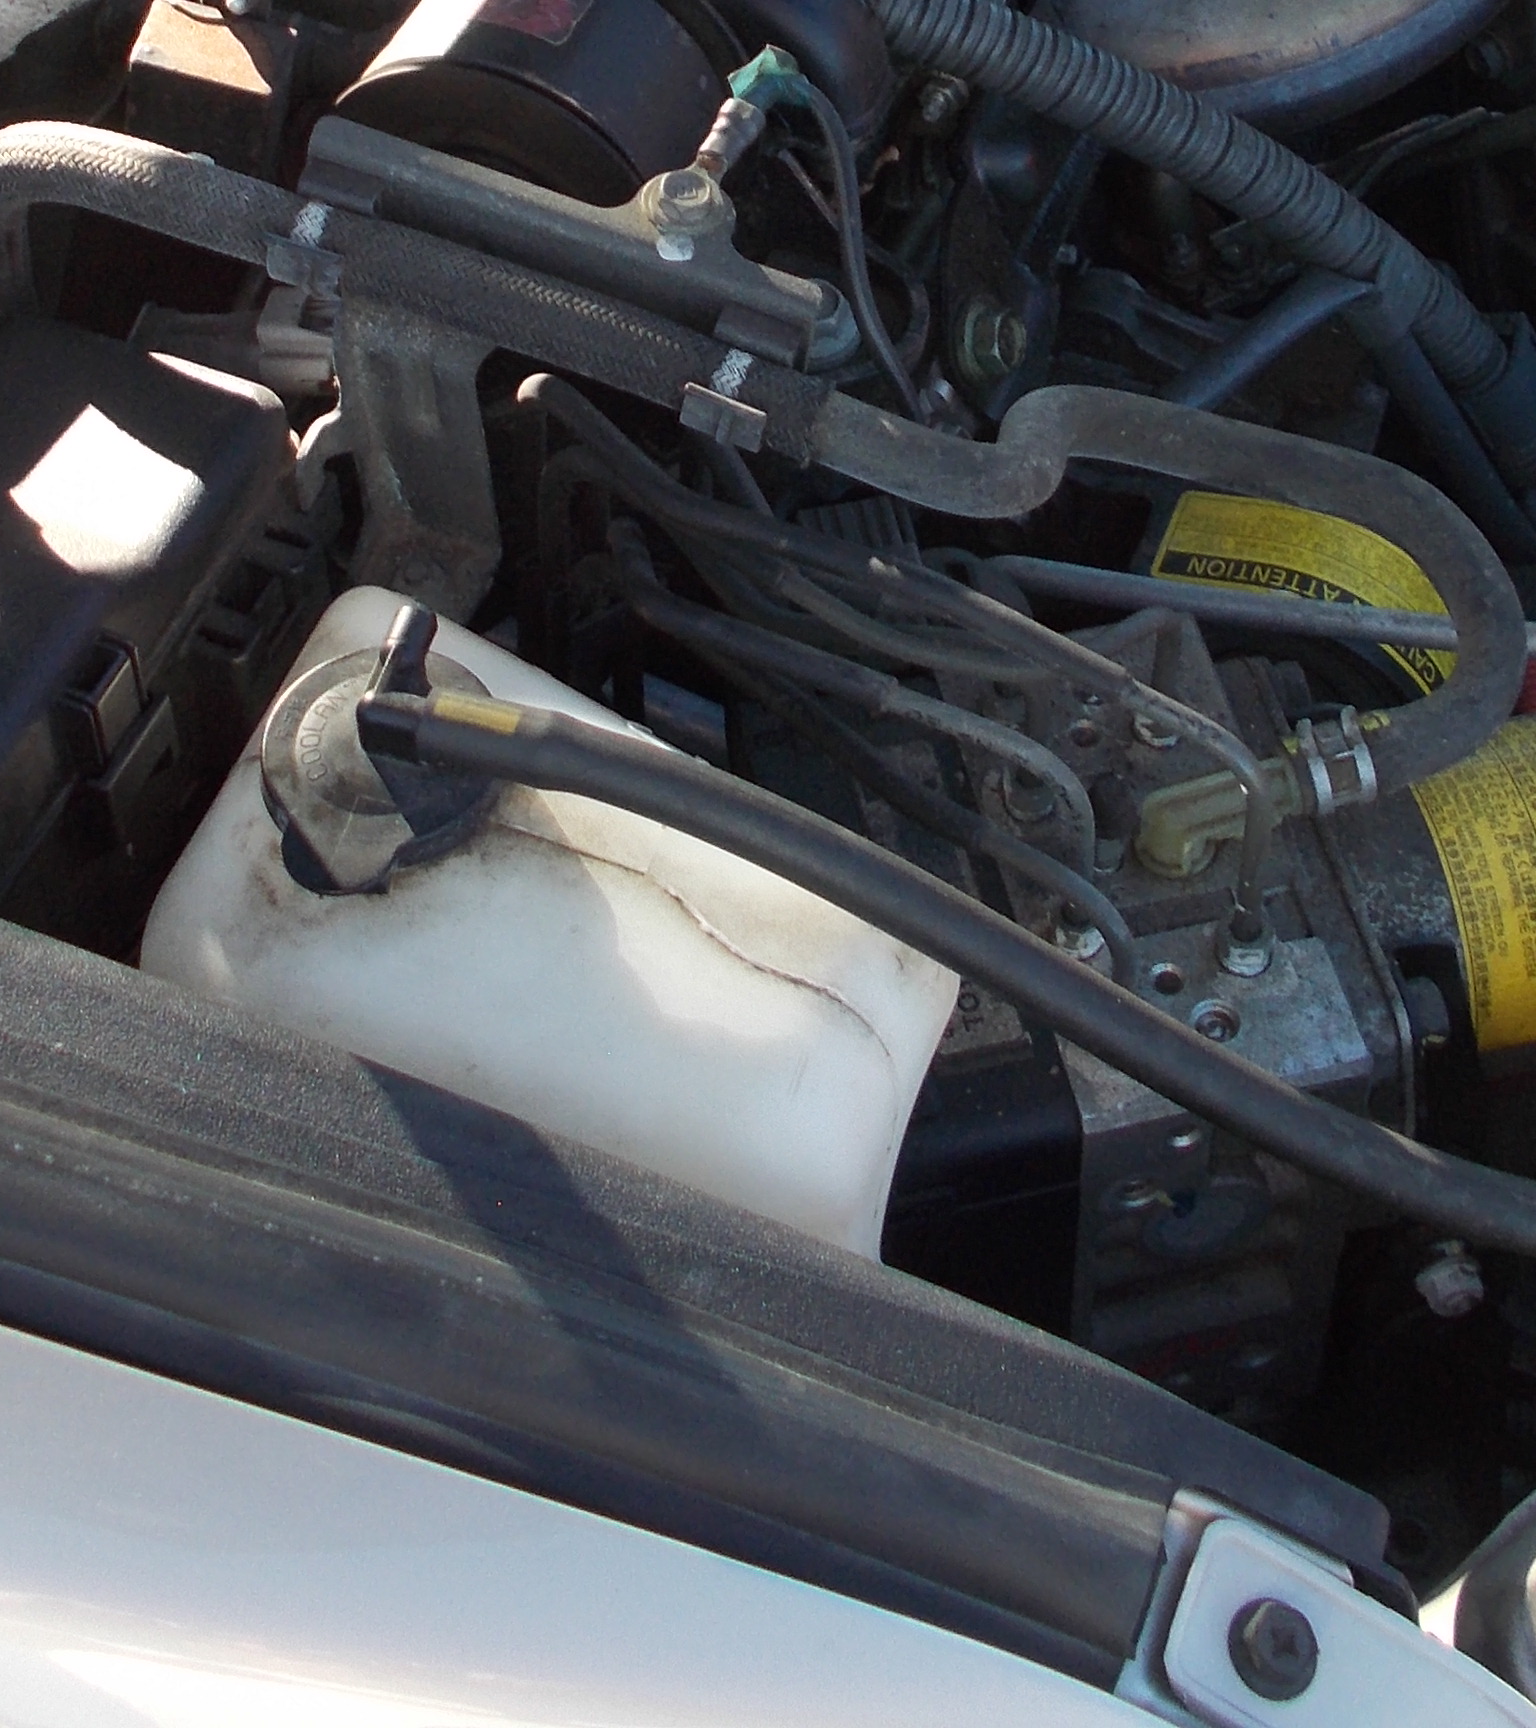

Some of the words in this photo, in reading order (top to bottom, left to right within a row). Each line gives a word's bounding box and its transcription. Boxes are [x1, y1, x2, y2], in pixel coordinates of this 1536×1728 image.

[1186, 554, 1342, 605] ATTENTION
[1475, 852, 1494, 881] TOUT
[1515, 913, 1531, 935] THE
